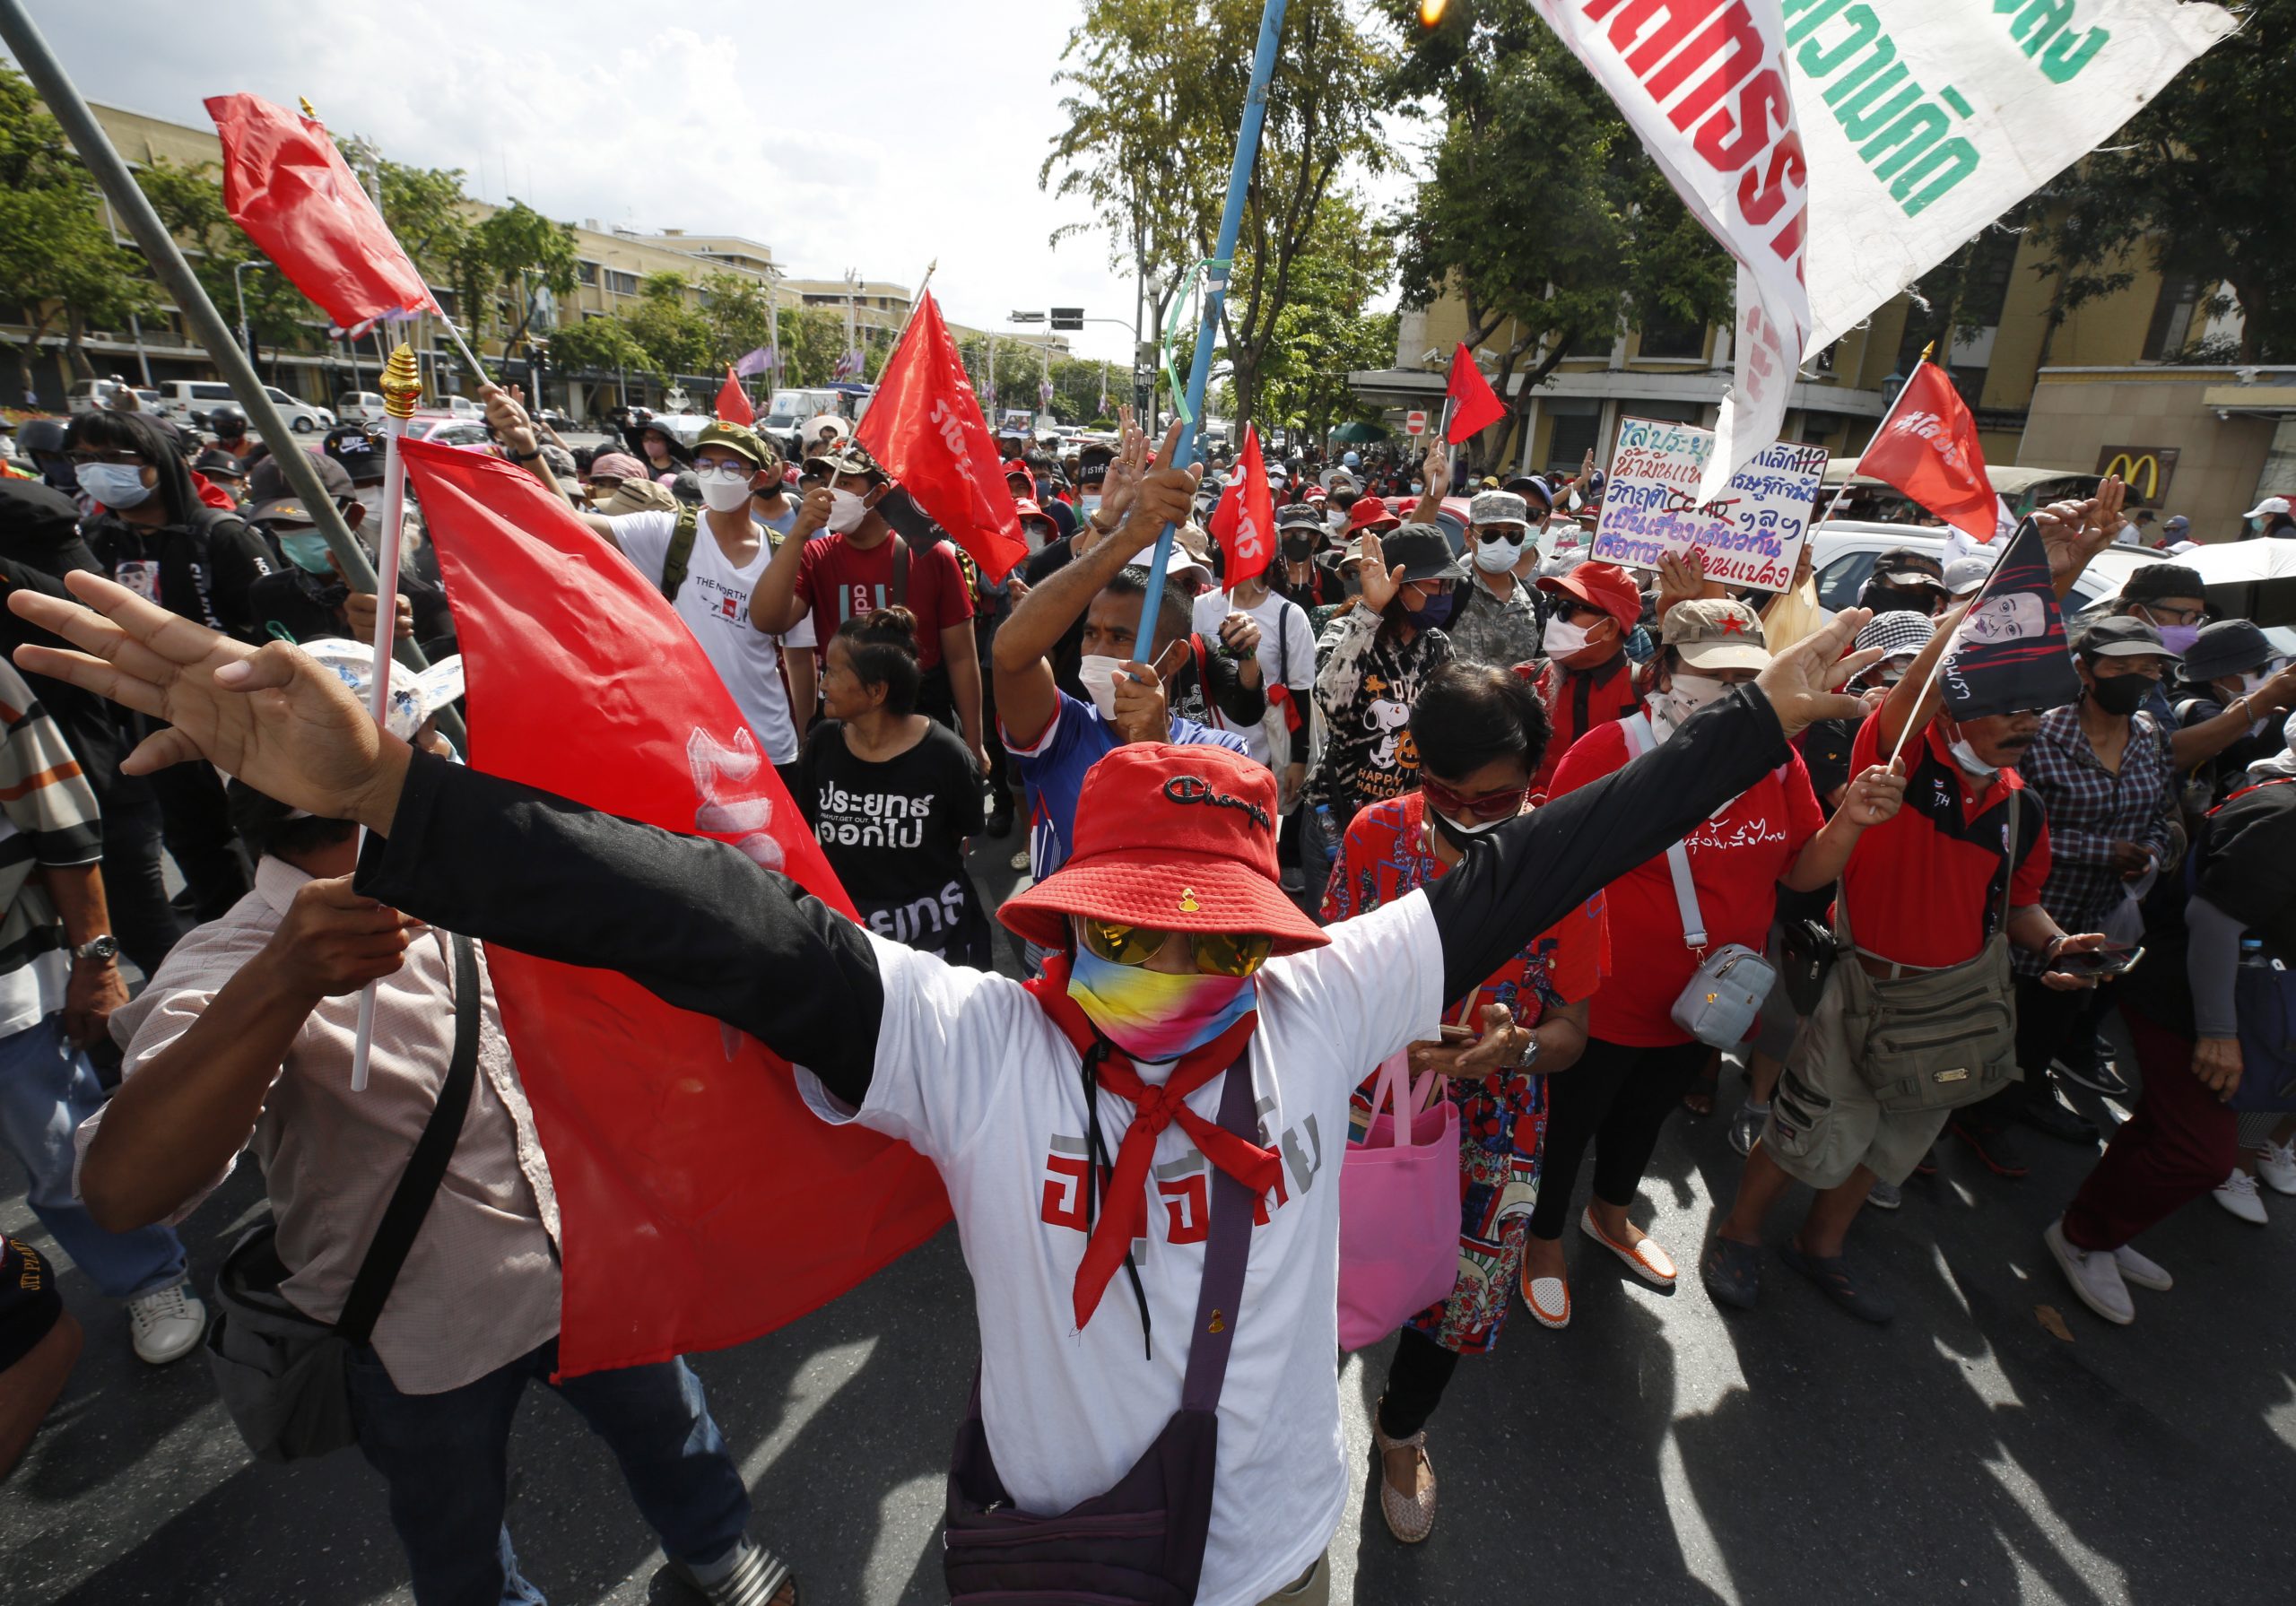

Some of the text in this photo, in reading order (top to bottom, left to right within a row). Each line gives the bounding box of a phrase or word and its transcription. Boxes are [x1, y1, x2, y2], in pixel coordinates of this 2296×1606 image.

[1613, 447, 1819, 503] น้ำมันแพ รษฐกิจพัง
[696, 576, 747, 602] THE NORTH
[1358, 768, 1404, 787] HAPPY
